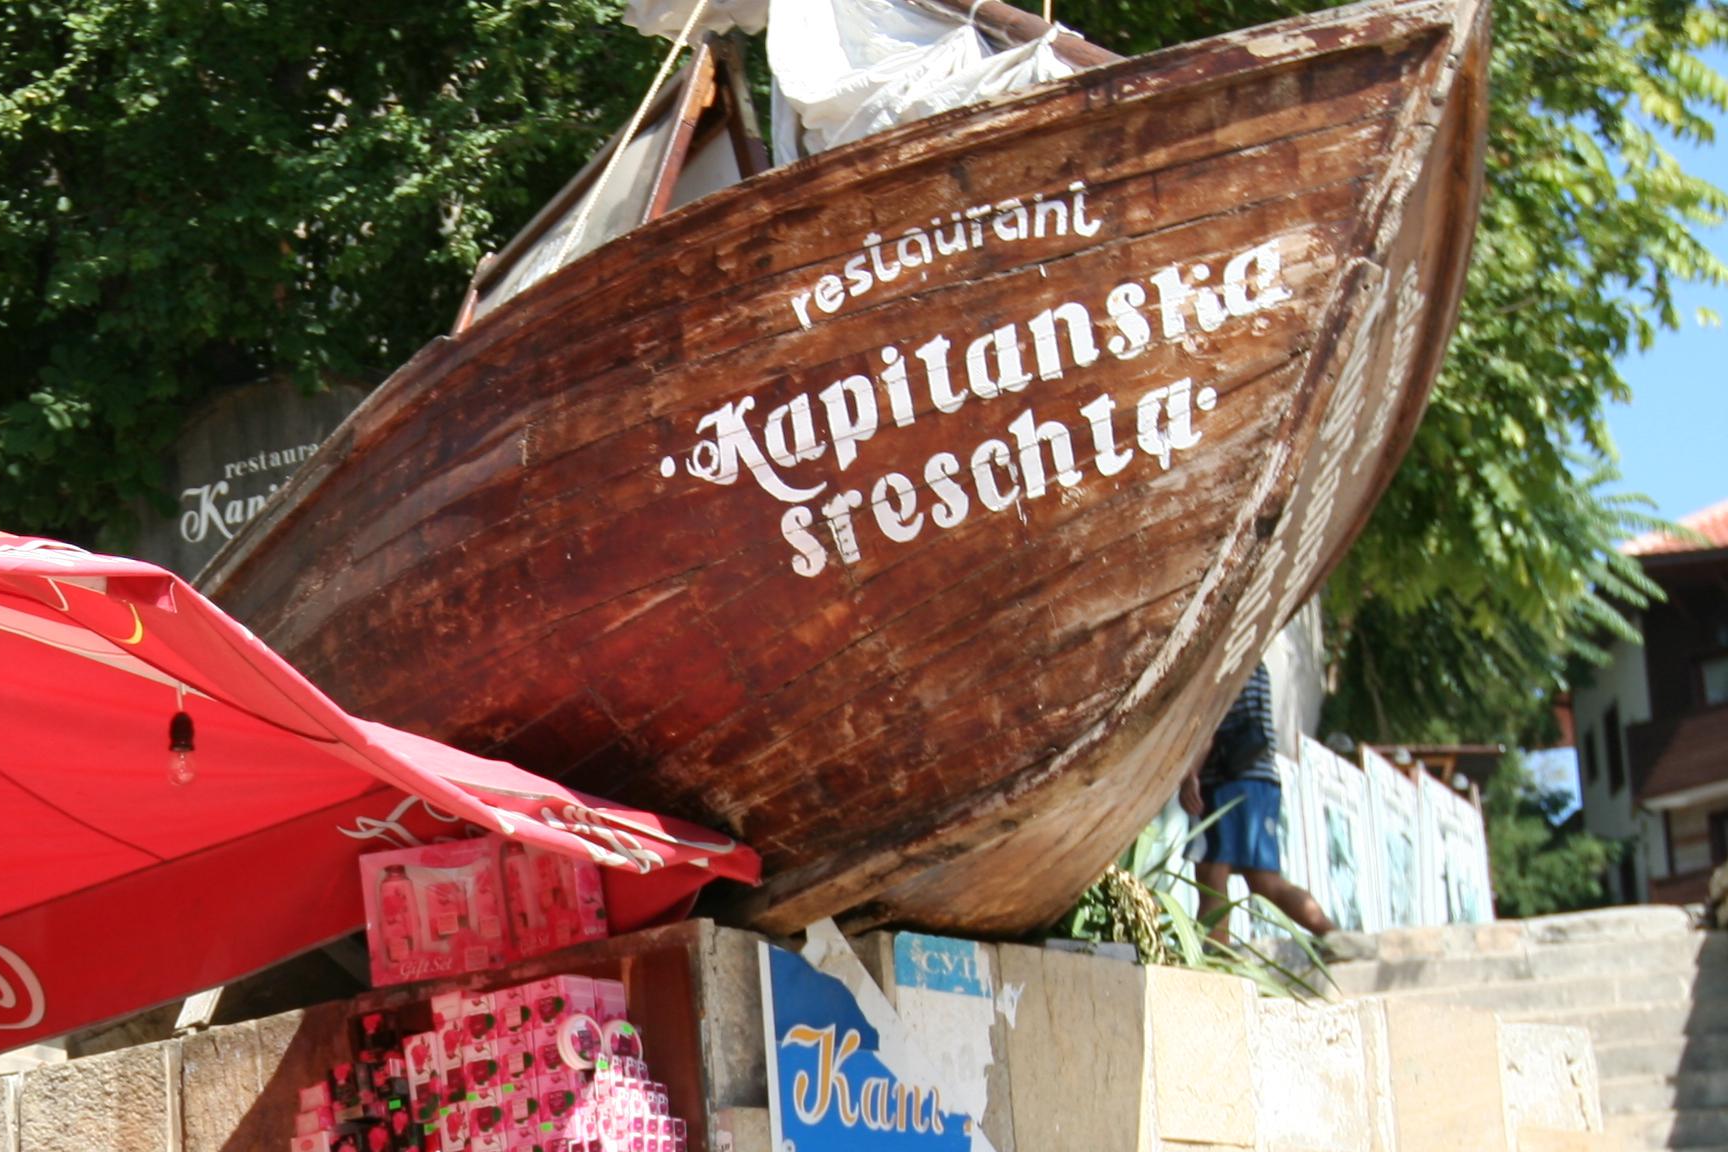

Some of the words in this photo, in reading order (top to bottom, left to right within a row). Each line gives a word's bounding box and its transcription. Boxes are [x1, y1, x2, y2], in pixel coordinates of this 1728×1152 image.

[790, 180, 1103, 330] restaurant
[685, 238, 1293, 503] Kapitanska
[180, 480, 279, 544] Kap
[780, 376, 1206, 578] sreschta
